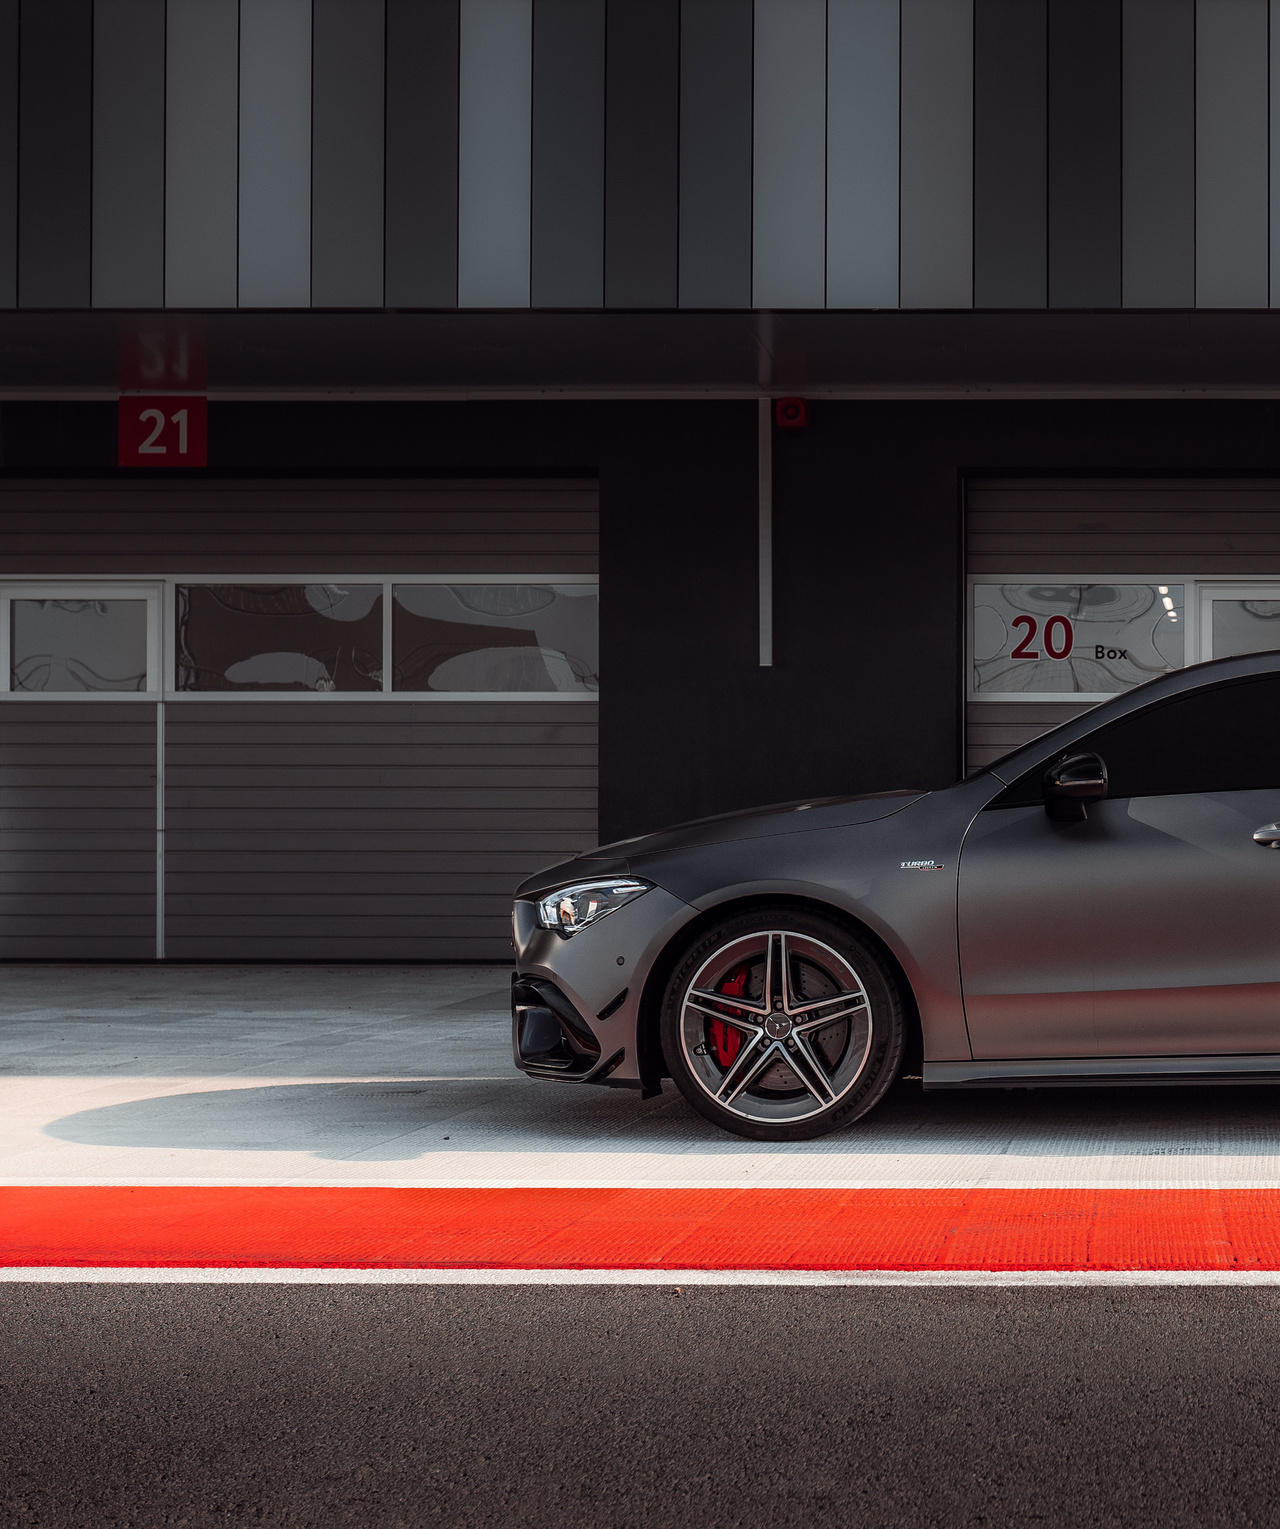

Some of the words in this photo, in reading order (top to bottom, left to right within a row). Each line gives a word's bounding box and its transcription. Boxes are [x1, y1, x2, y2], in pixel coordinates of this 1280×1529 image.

[138, 408, 188, 454] 21
[1010, 615, 1075, 660] 20
[1095, 645, 1128, 660] Box
[900, 860, 935, 868] TURBO
[673, 933, 719, 990] MICHELIN
